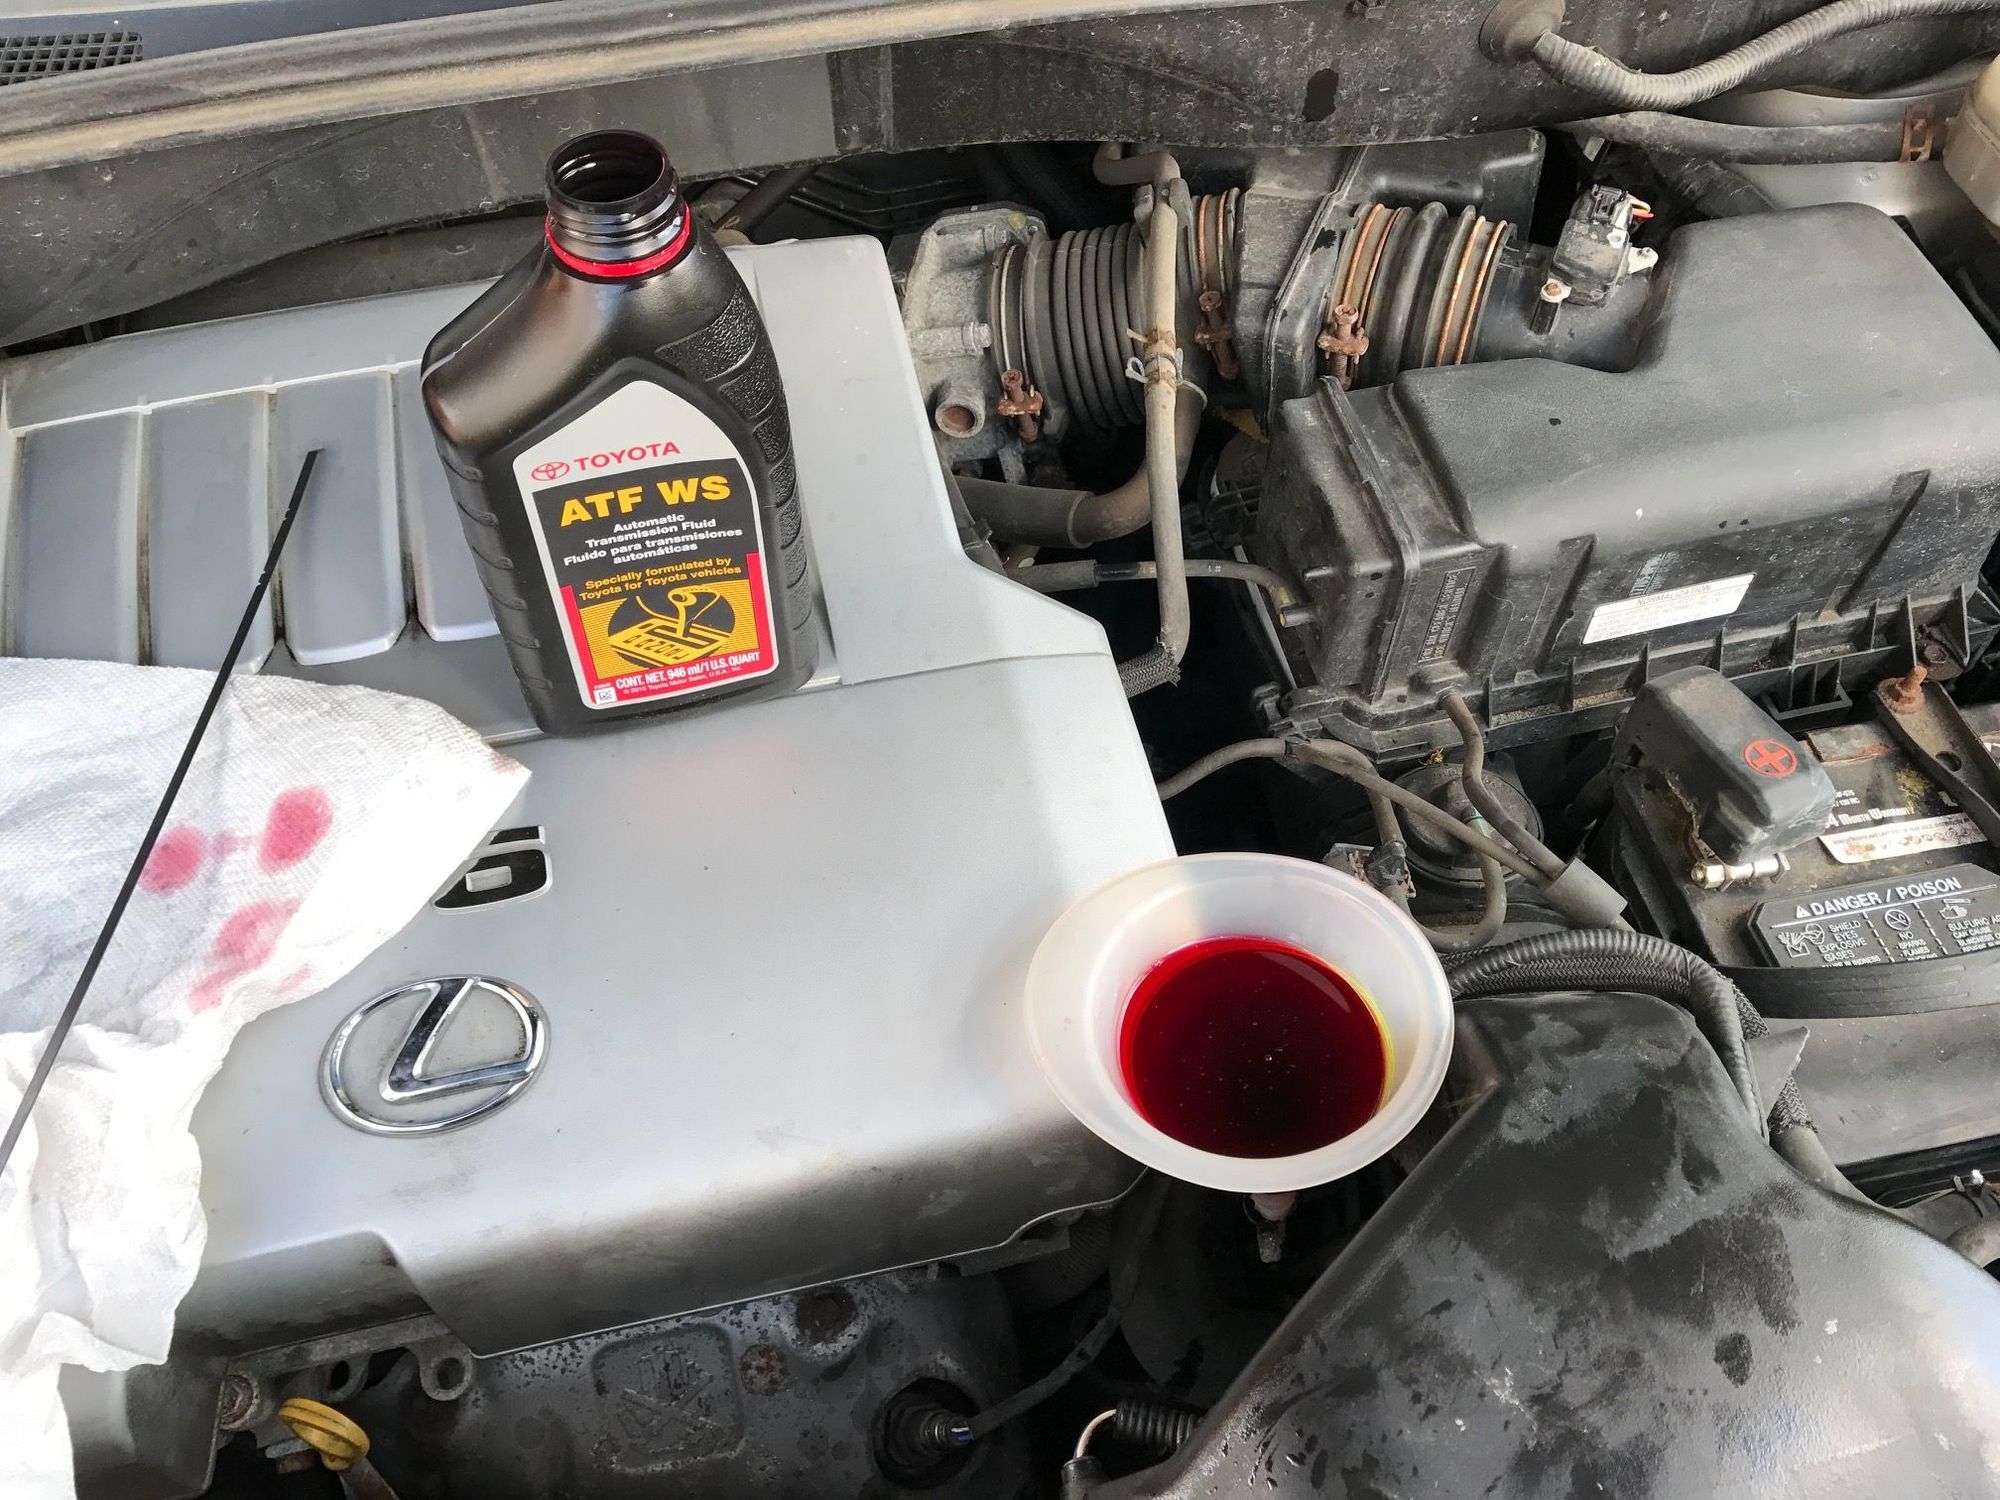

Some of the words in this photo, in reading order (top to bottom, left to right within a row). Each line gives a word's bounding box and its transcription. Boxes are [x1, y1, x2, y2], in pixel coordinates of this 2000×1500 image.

[574, 442, 680, 471] TOYOTA
[560, 486, 643, 527] ATF
[656, 476, 731, 506] WS
[585, 526, 678, 549] Transmission
[682, 518, 716, 531] Fluid
[613, 514, 685, 533] Automatic
[563, 550, 606, 566] Fluido
[610, 543, 642, 557] para
[645, 528, 743, 548] transmisiones
[613, 543, 698, 564] automáticas
[585, 570, 642, 590] Specially
[646, 560, 712, 576] formulated
[716, 556, 732, 567] by
[578, 586, 622, 602] Toyota
[624, 580, 642, 590] for
[646, 573, 688, 588] Toyota
[690, 566, 742, 578] vehicles
[616, 676, 645, 690] CONT.
[646, 672, 666, 684] NET.
[667, 668, 686, 681] 946
[687, 662, 710, 678] ml/1
[710, 658, 728, 670] U.S.
[728, 652, 760, 667] QUART
[647, 682, 669, 691] Toyota
[1810, 892, 1882, 916] DANGER
[1885, 888, 1892, 903] /
[1894, 877, 1962, 900] POISON
[1828, 919, 1862, 933] SHIELD
[1948, 917, 1989, 931] SULFURIC
[1835, 930, 1858, 942] EYES
[1898, 930, 1914, 940] NO
[1818, 938, 1868, 954] EXPLOSIVE
[1824, 950, 1855, 962] GASES
